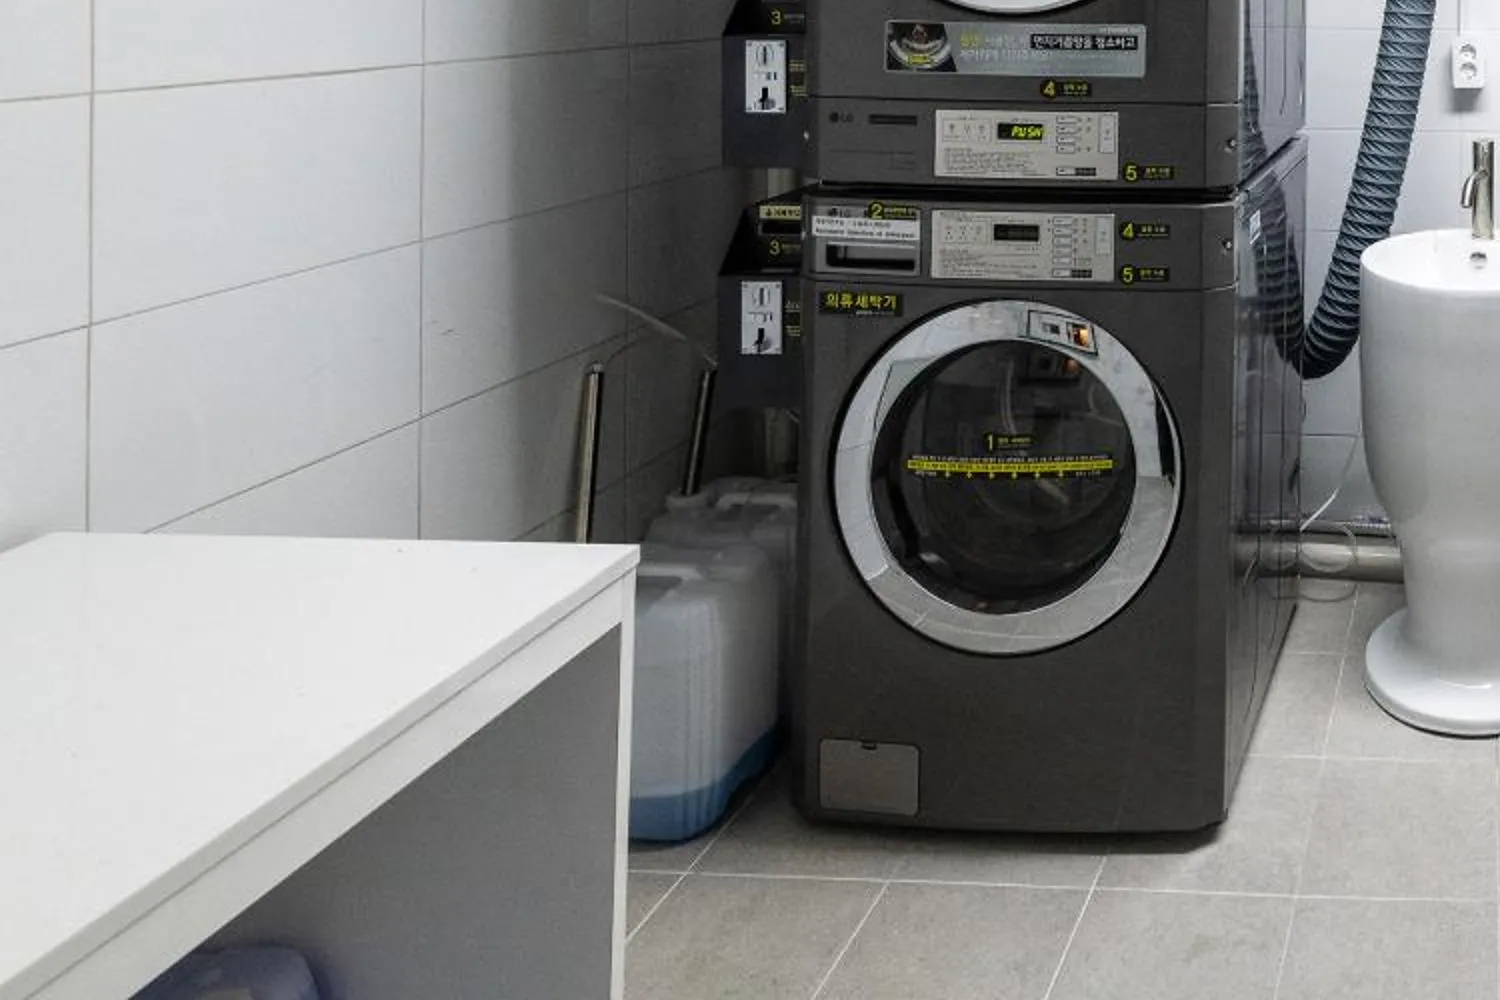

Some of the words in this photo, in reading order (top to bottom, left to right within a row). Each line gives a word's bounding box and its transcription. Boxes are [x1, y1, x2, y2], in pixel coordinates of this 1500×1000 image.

[771, 11, 781, 25] 3
[1043, 81, 1054, 96] 4
[1126, 165, 1137, 181] 5
[871, 203, 882, 219] 2
[1123, 223, 1134, 238] 4
[769, 240, 781, 255] 3
[1122, 267, 1133, 283] 5
[826, 292, 897, 310] 의류세탁기
